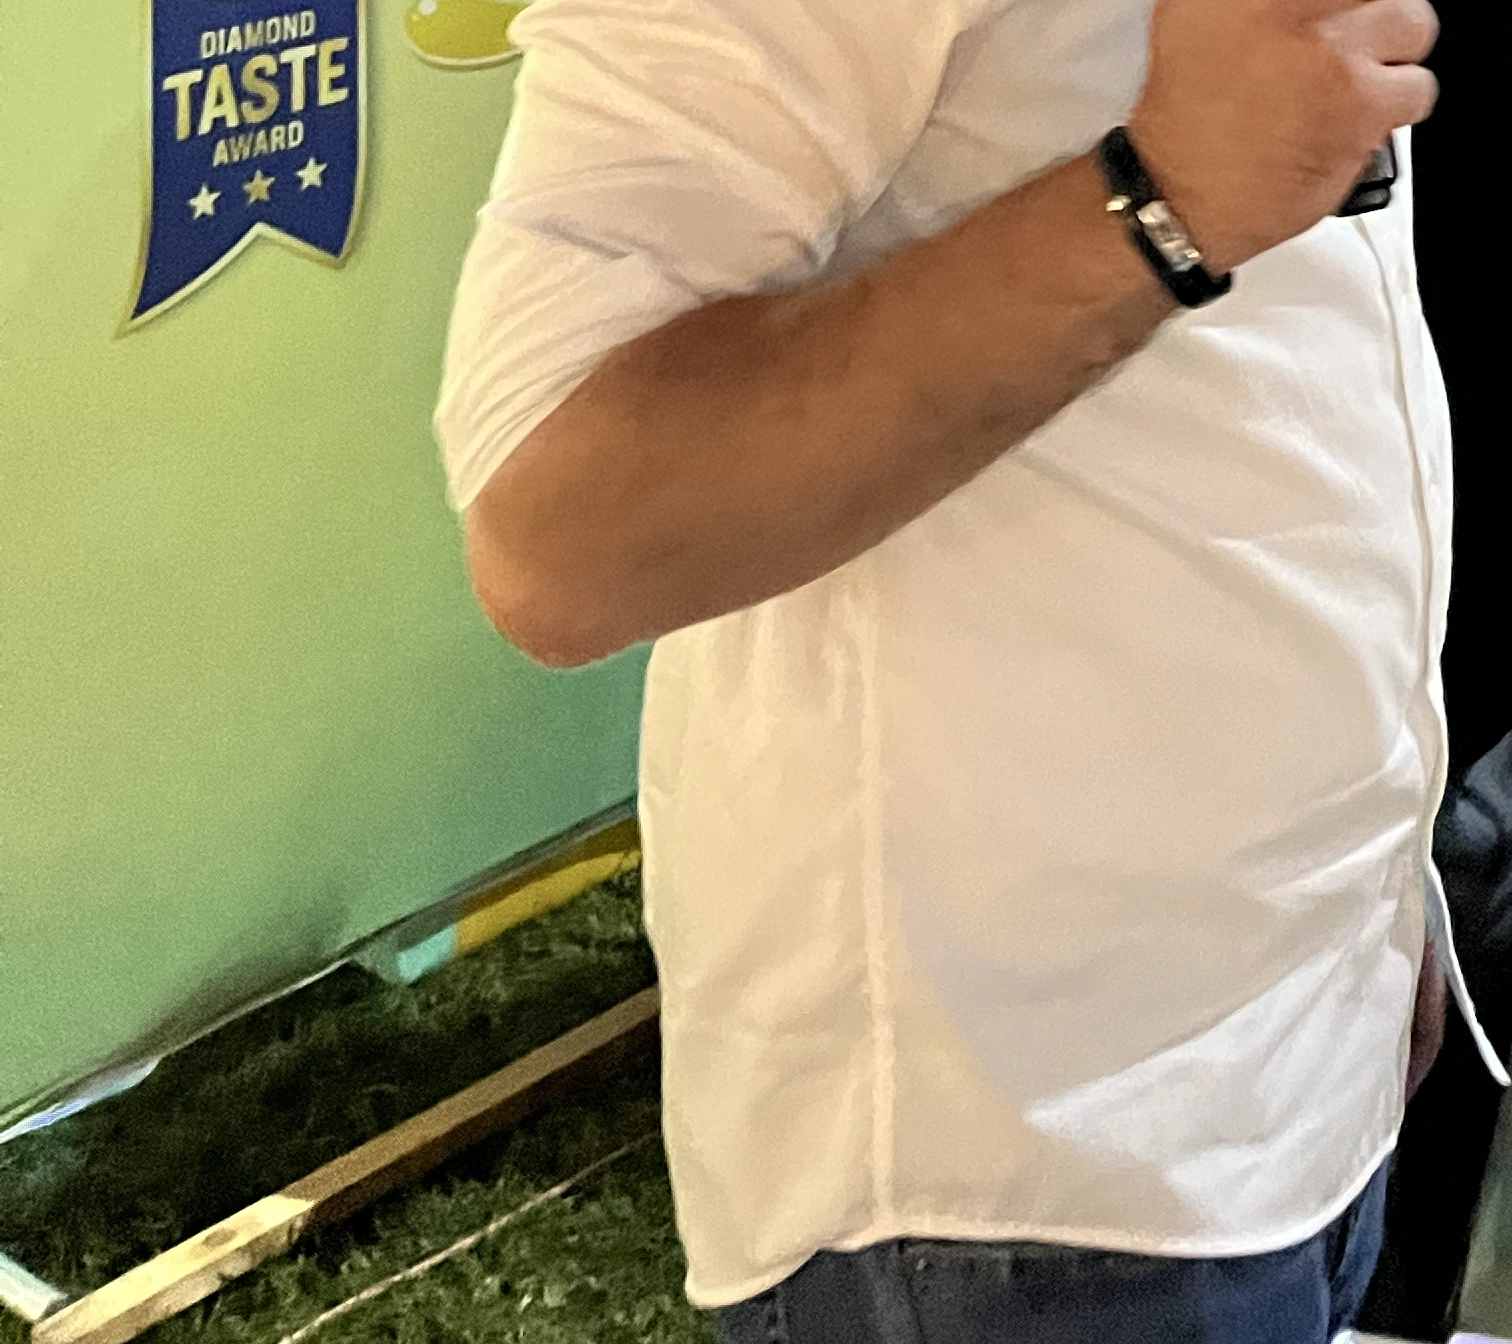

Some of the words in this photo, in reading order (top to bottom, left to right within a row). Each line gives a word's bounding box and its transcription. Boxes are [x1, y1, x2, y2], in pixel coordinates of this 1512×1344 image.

[200, 10, 317, 59] DIAMOND
[162, 36, 350, 142] TASTE
[212, 120, 305, 168] AWARD
